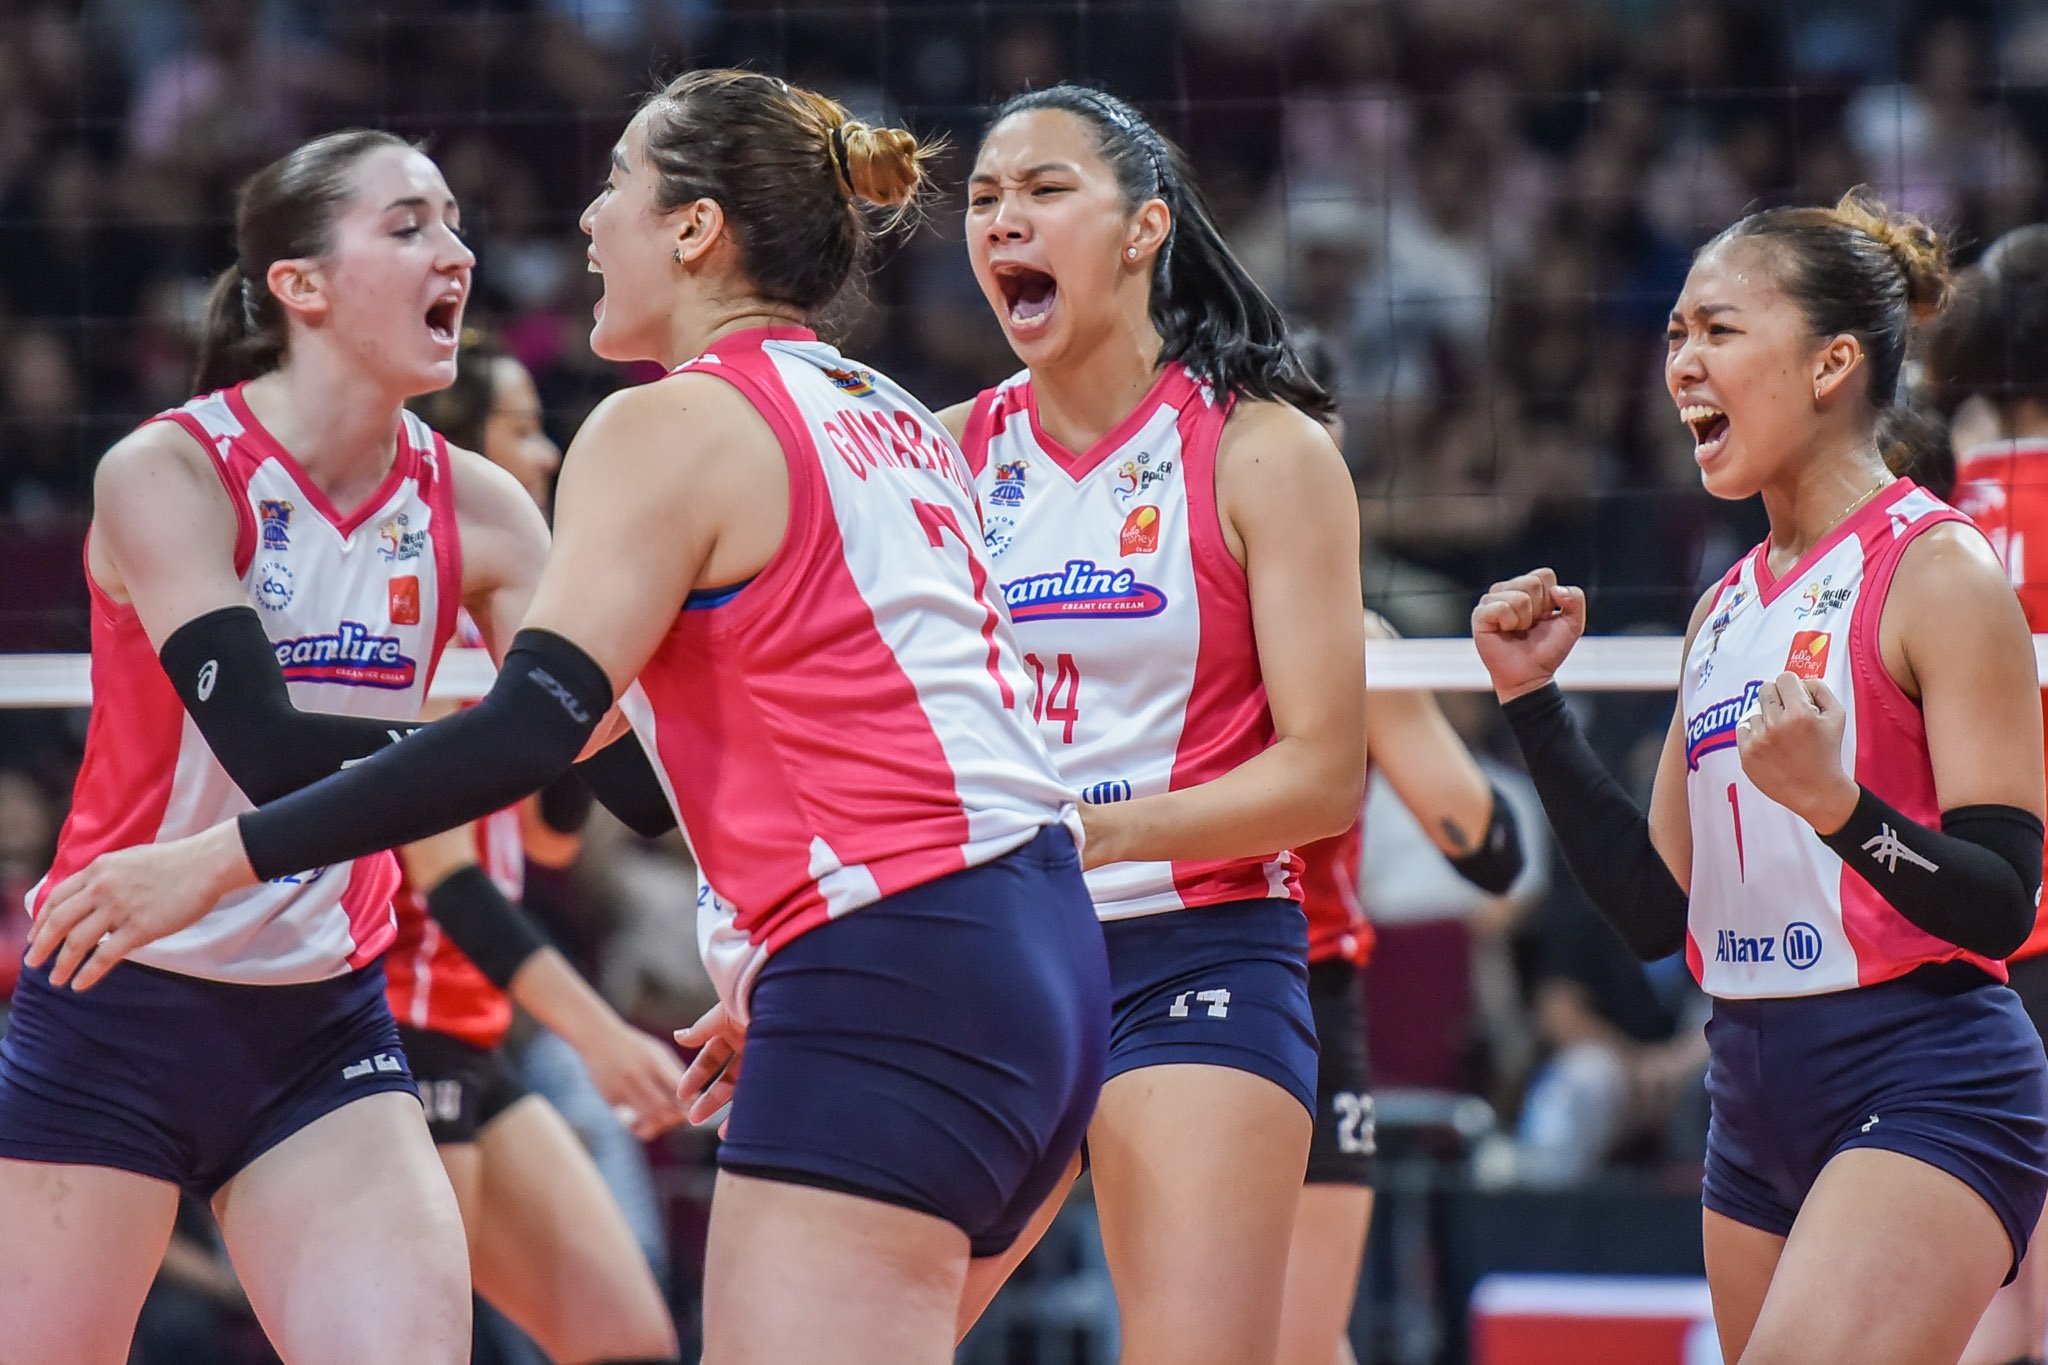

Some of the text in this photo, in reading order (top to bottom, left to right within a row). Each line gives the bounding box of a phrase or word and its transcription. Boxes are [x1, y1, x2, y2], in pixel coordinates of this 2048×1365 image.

[910, 497, 1015, 710] 7
[1000, 564, 1132, 605] amline
[1062, 602, 1095, 610] CREAMY
[1114, 601, 1145, 609] CREAM
[274, 625, 400, 667] eamline
[1790, 660, 1823, 673] money
